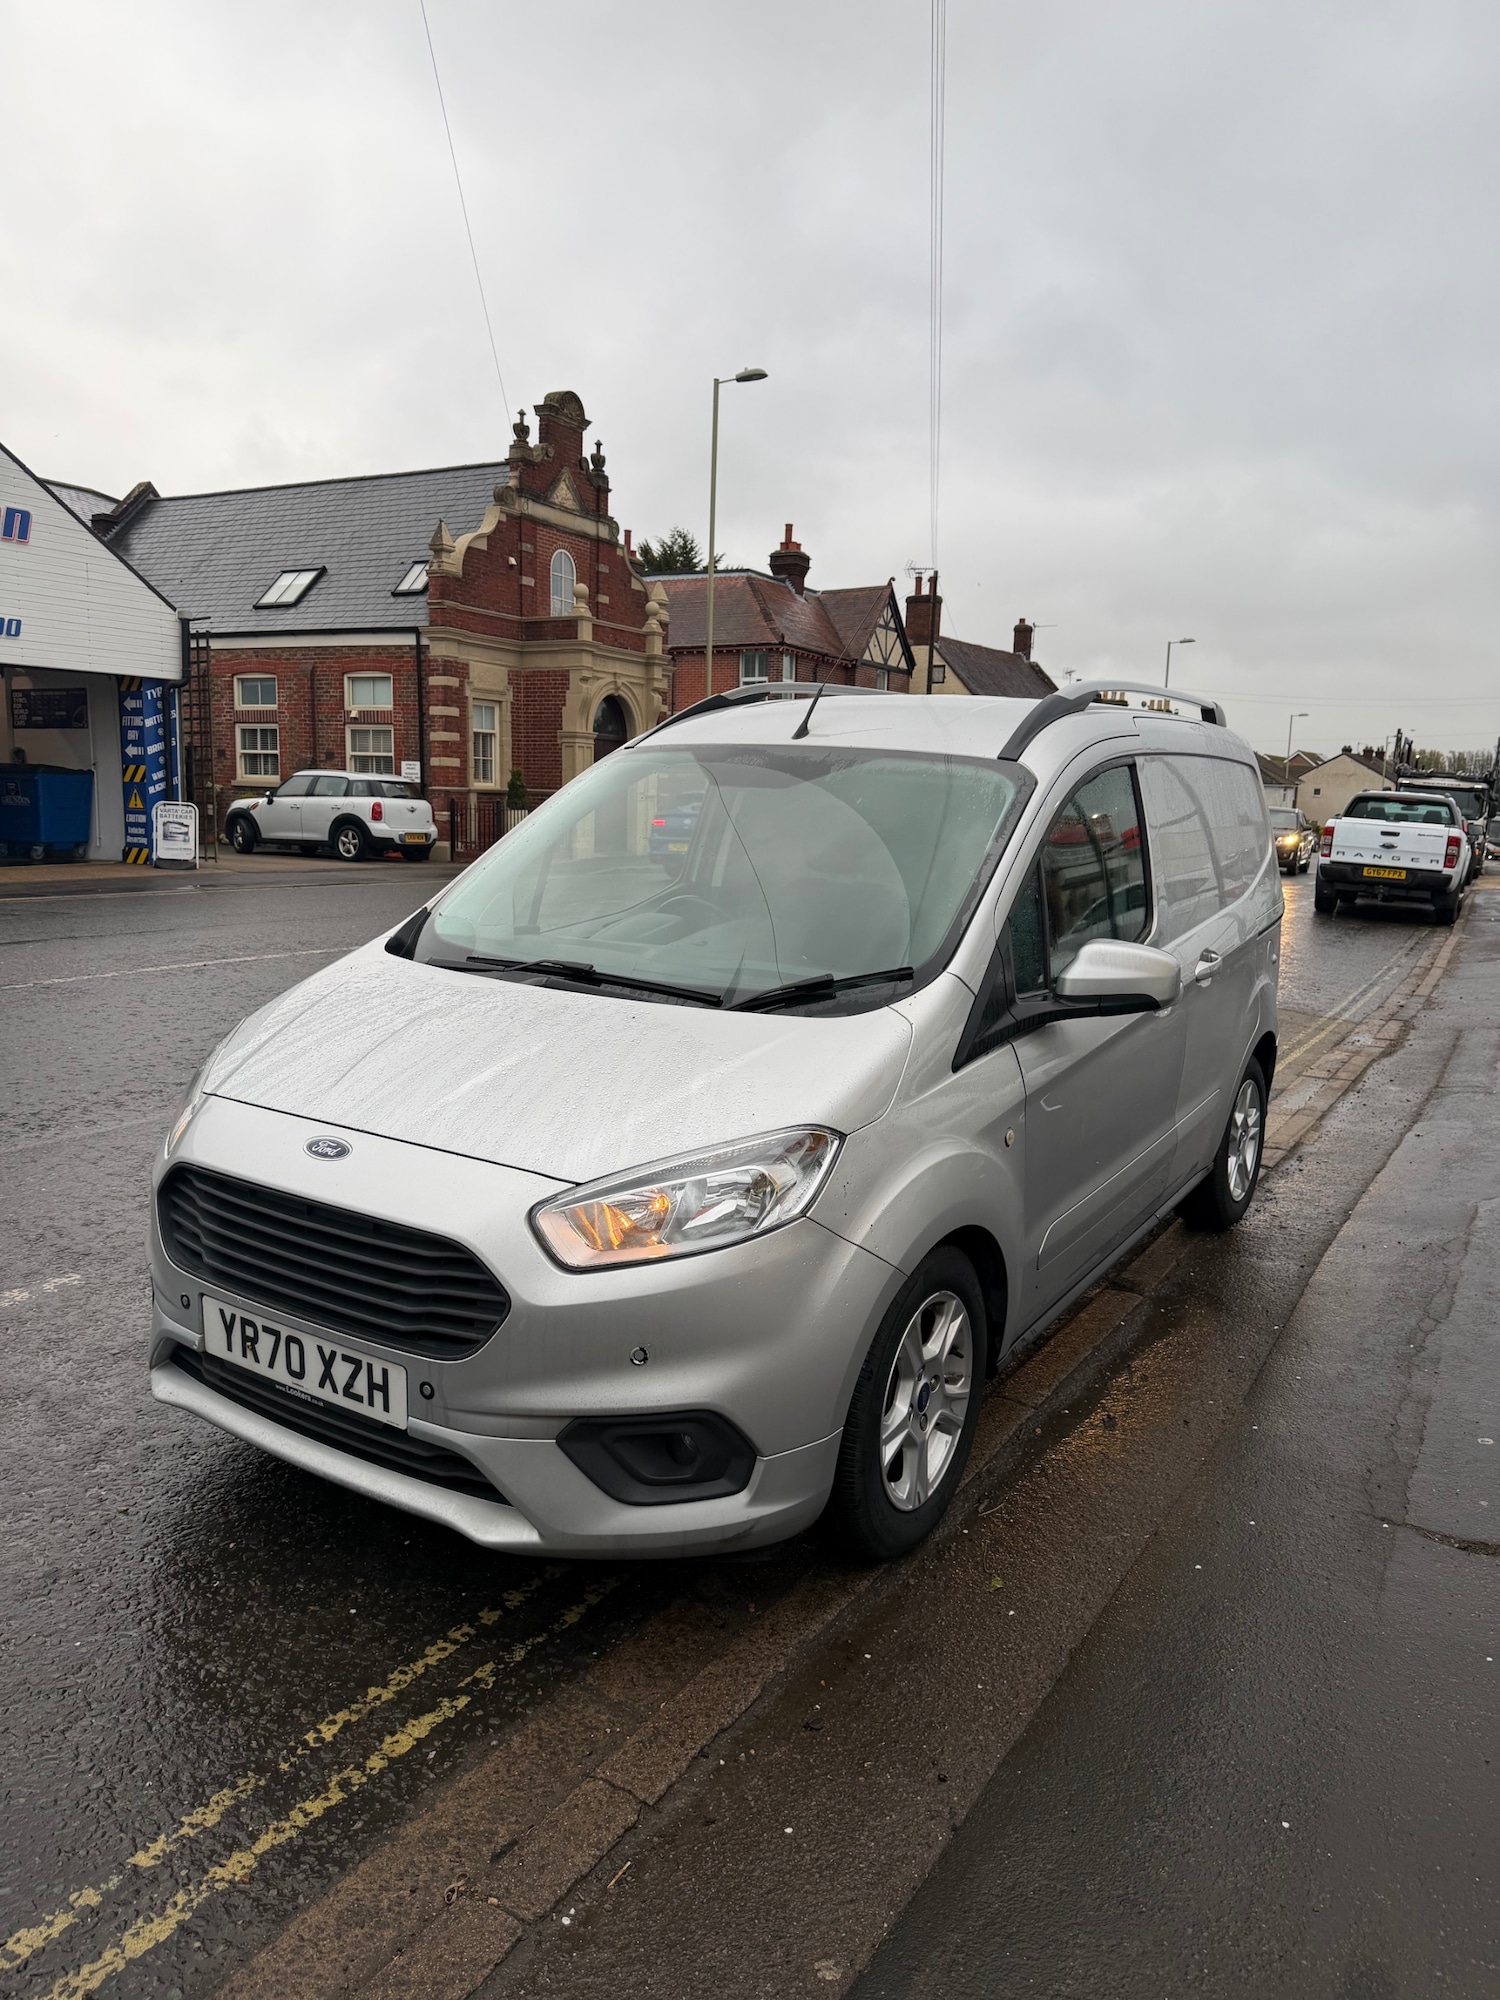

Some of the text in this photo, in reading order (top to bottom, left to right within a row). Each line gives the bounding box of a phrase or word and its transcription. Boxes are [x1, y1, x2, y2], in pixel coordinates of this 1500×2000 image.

[122, 716, 143, 726] FITTING
[127, 730, 139, 740] BAY
[126, 814, 146, 823] CAUTION
[1336, 851, 1439, 864] RANGER
[1366, 868, 1403, 878] GY67 FPX
[312, 1140, 341, 1156] Ford
[219, 1308, 390, 1414] YR70 XZH
